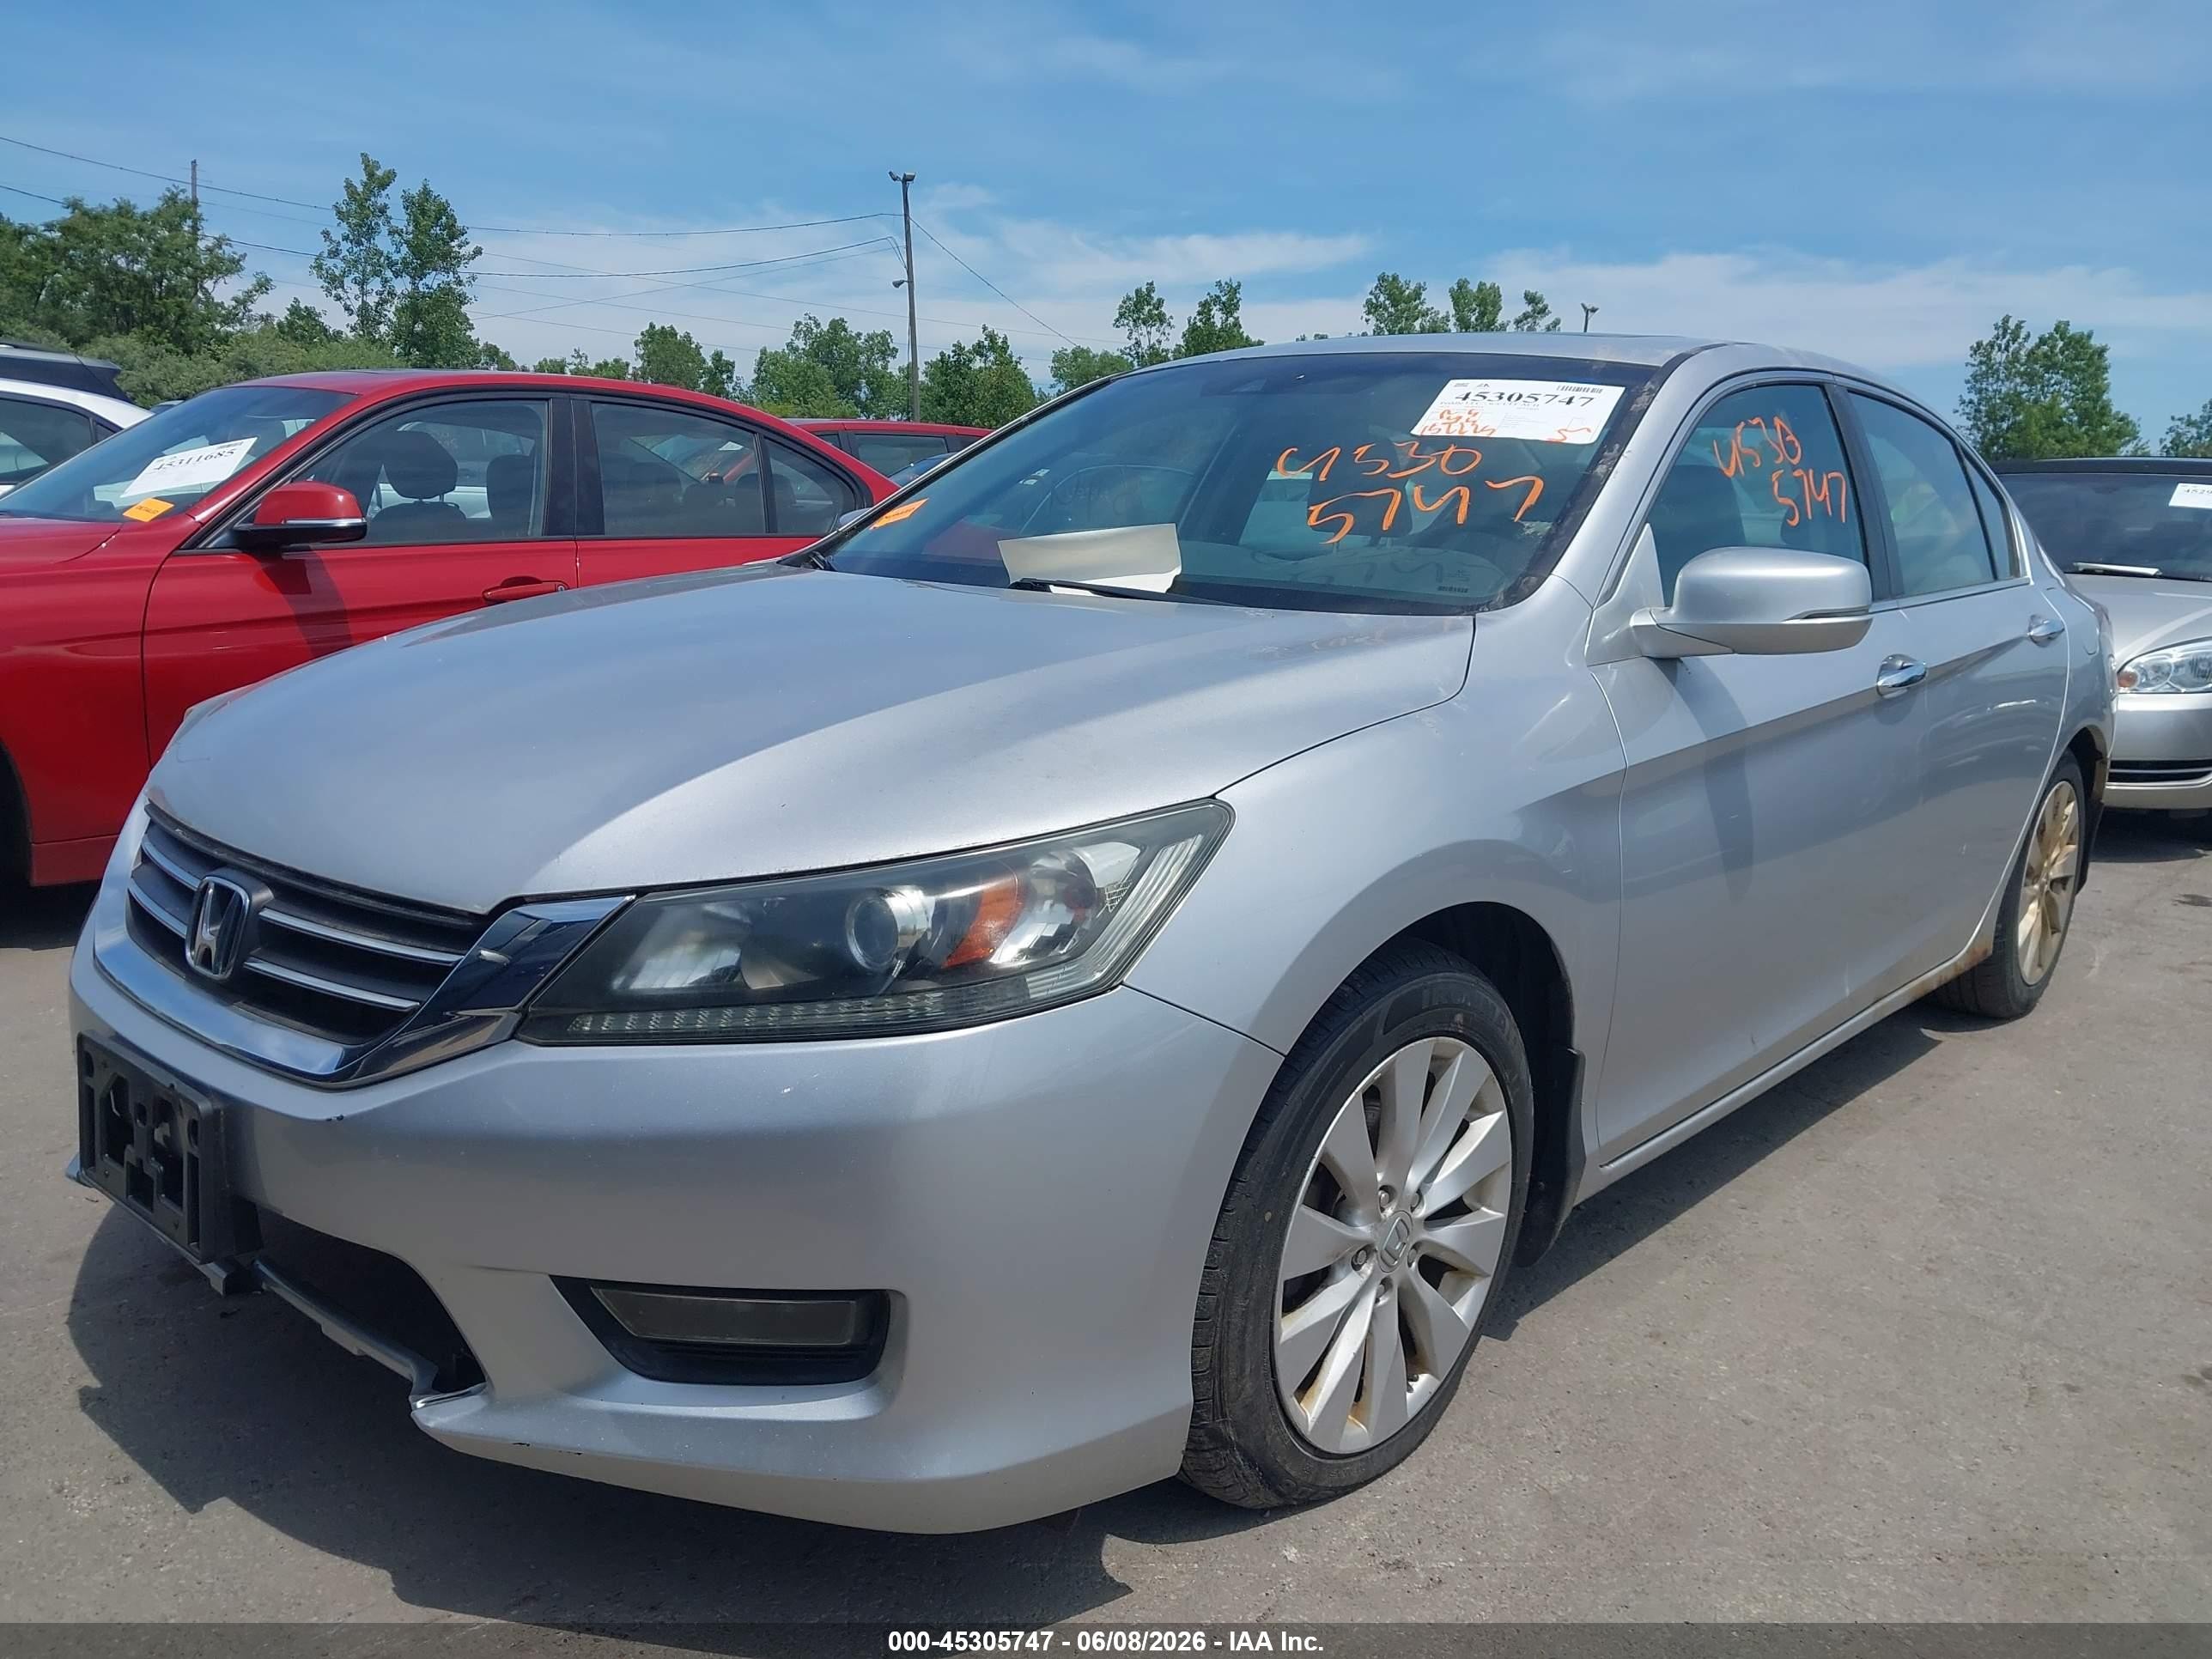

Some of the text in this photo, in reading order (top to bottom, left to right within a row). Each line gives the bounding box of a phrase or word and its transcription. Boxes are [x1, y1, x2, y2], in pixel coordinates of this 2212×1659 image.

[1455, 391, 1596, 407] 45305747
[1307, 475, 1545, 545] 5747
[1771, 468, 1847, 527] 5747
